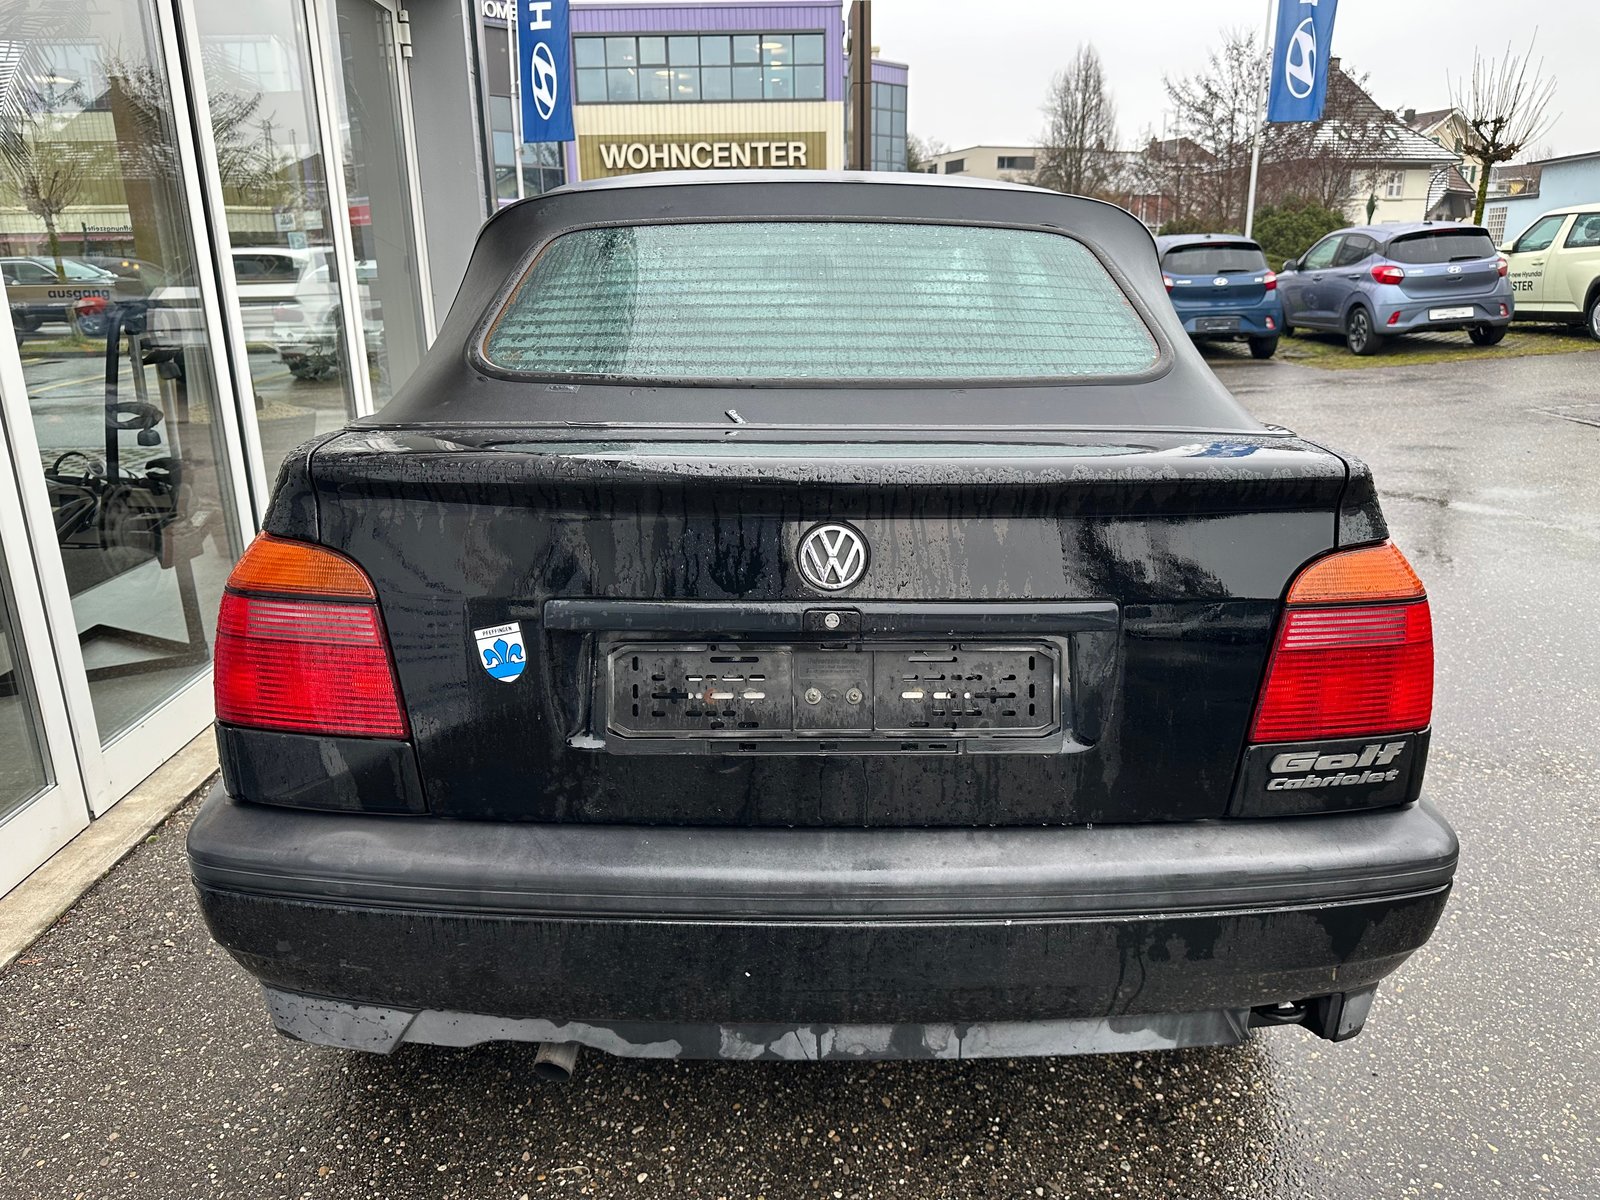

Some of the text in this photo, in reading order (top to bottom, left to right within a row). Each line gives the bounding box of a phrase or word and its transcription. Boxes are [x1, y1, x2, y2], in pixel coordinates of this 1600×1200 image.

[481, 0, 517, 20] OME
[600, 141, 807, 169] WOHNCENTER
[1510, 280, 1533, 291] STER
[48, 289, 110, 301] ausgang
[482, 626, 512, 636] PFEFFINGEN
[1270, 741, 1407, 774] Golf
